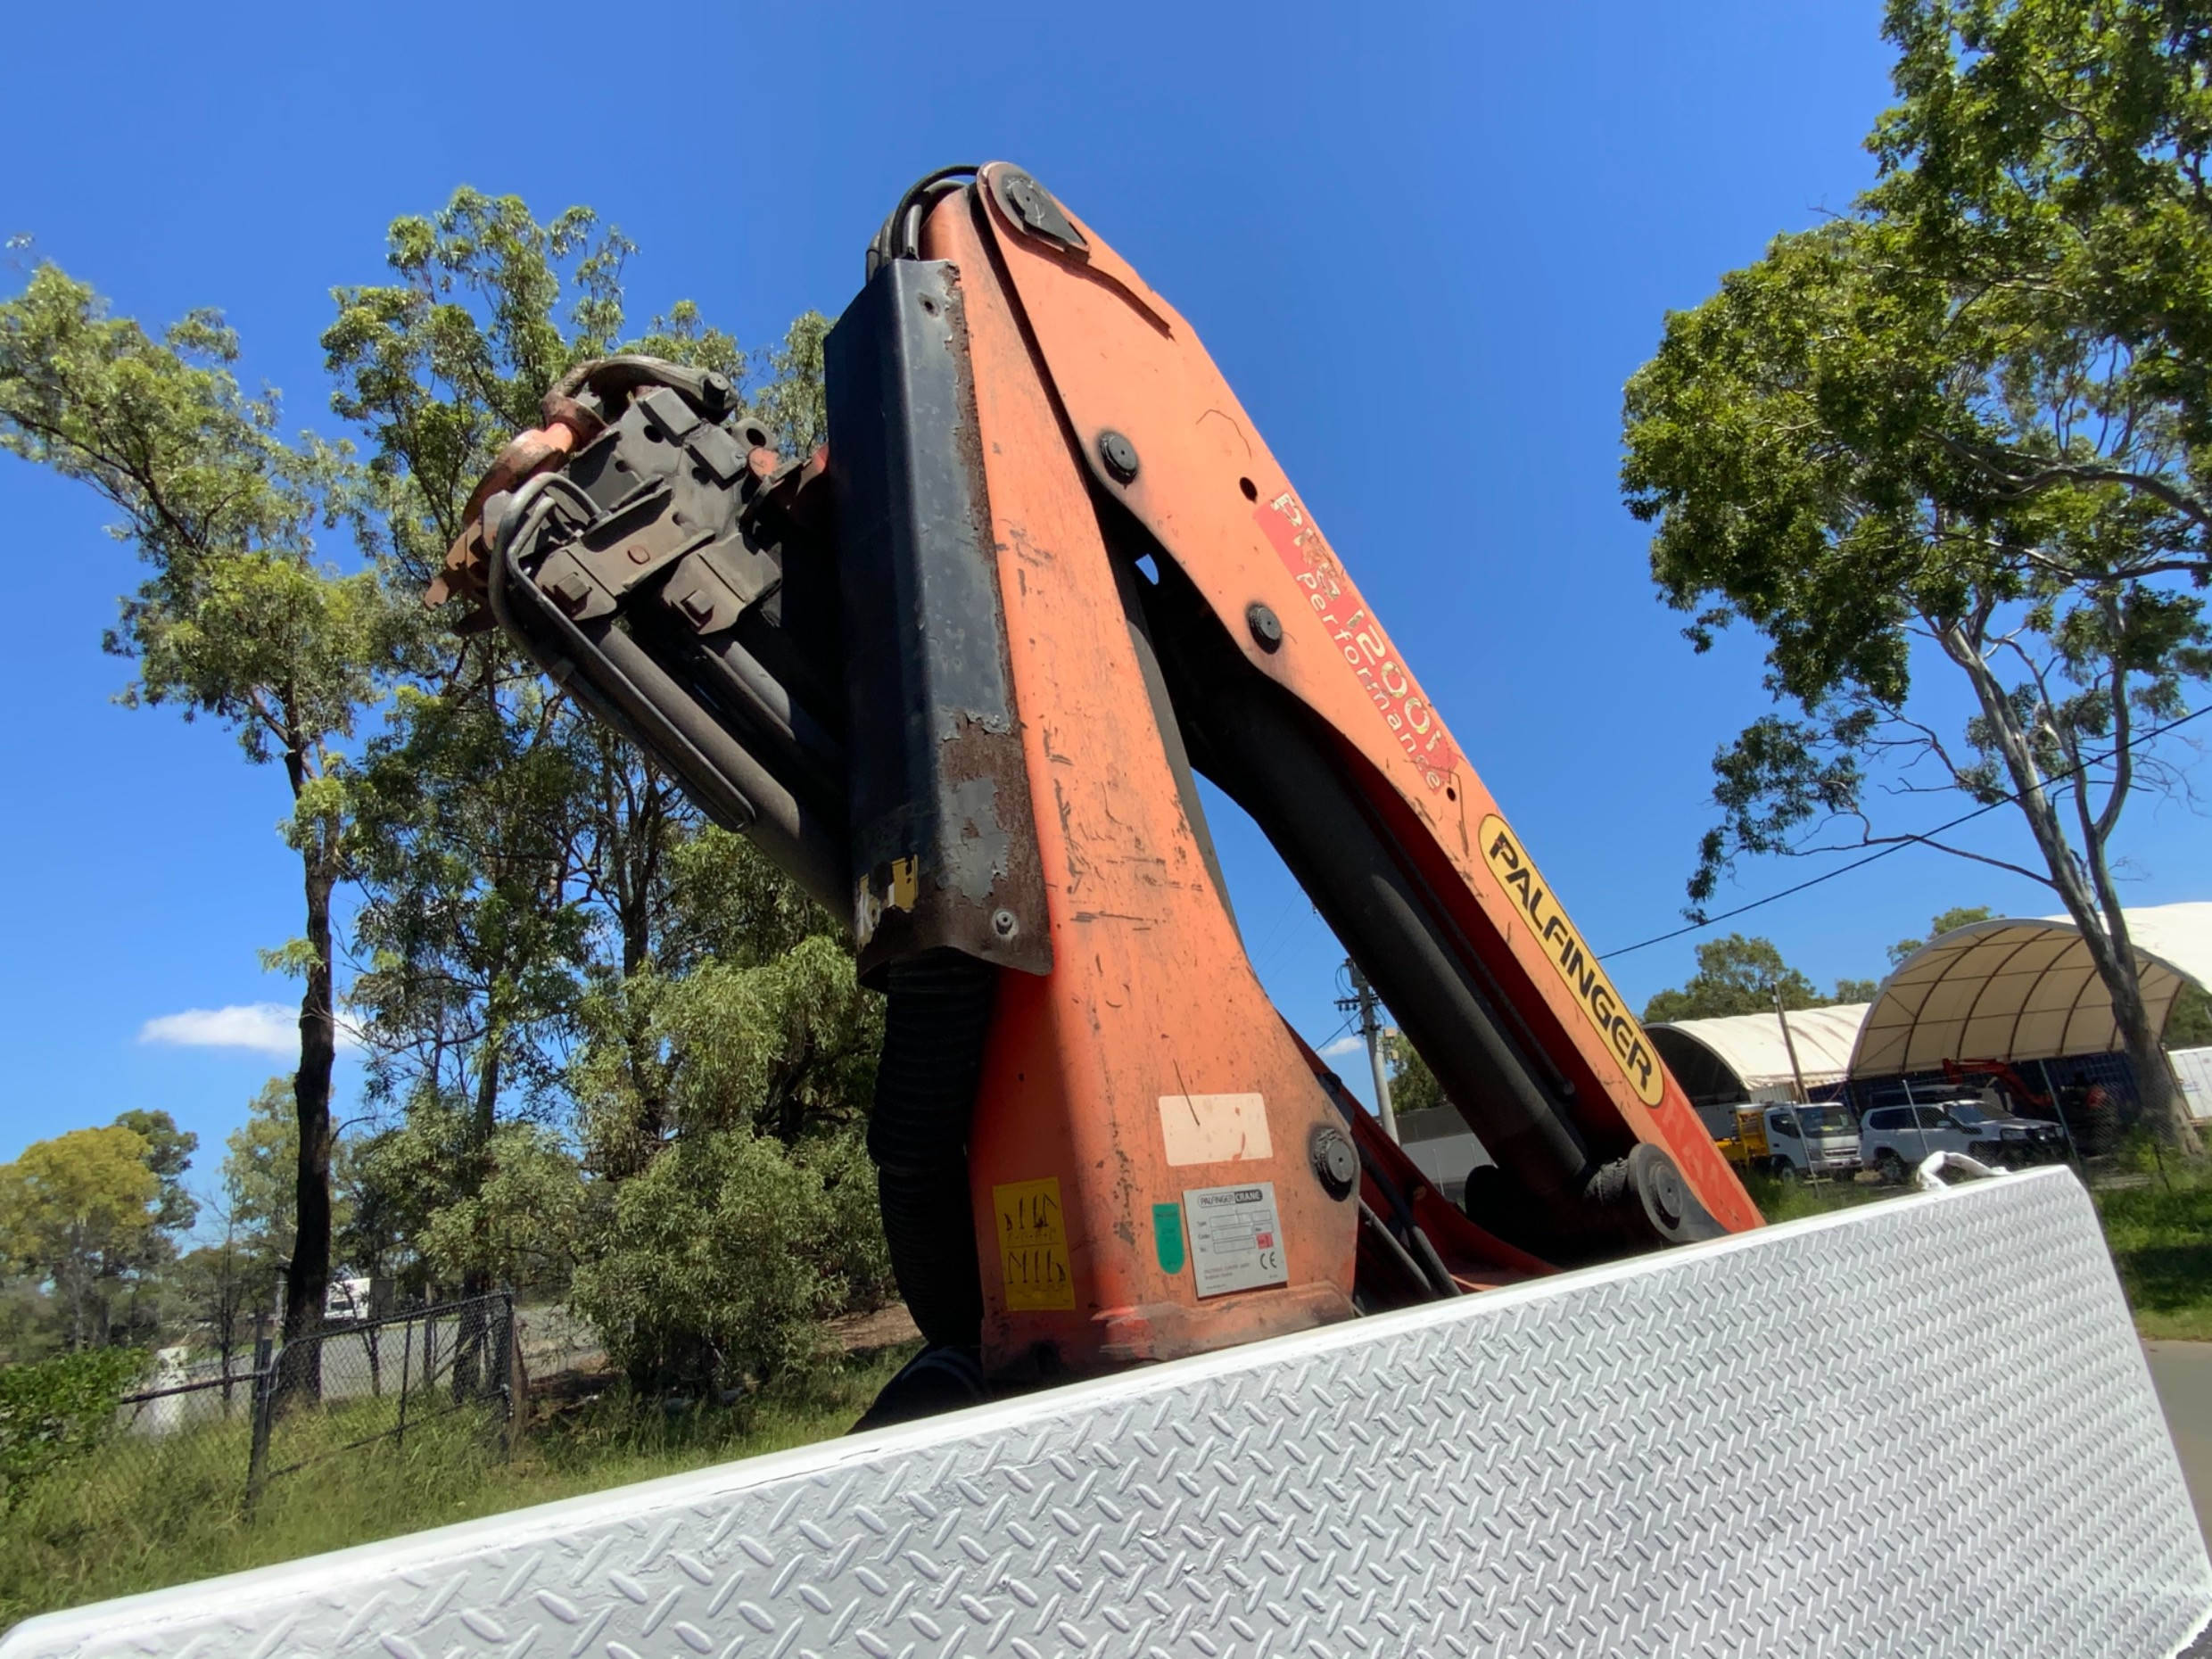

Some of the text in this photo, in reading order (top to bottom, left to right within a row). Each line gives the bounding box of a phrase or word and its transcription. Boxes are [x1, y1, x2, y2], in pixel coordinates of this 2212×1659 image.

[1296, 572, 1441, 790] Performance
[1490, 831, 1653, 1091] PALFINGER
[1235, 1191, 1260, 1203] CRANE
